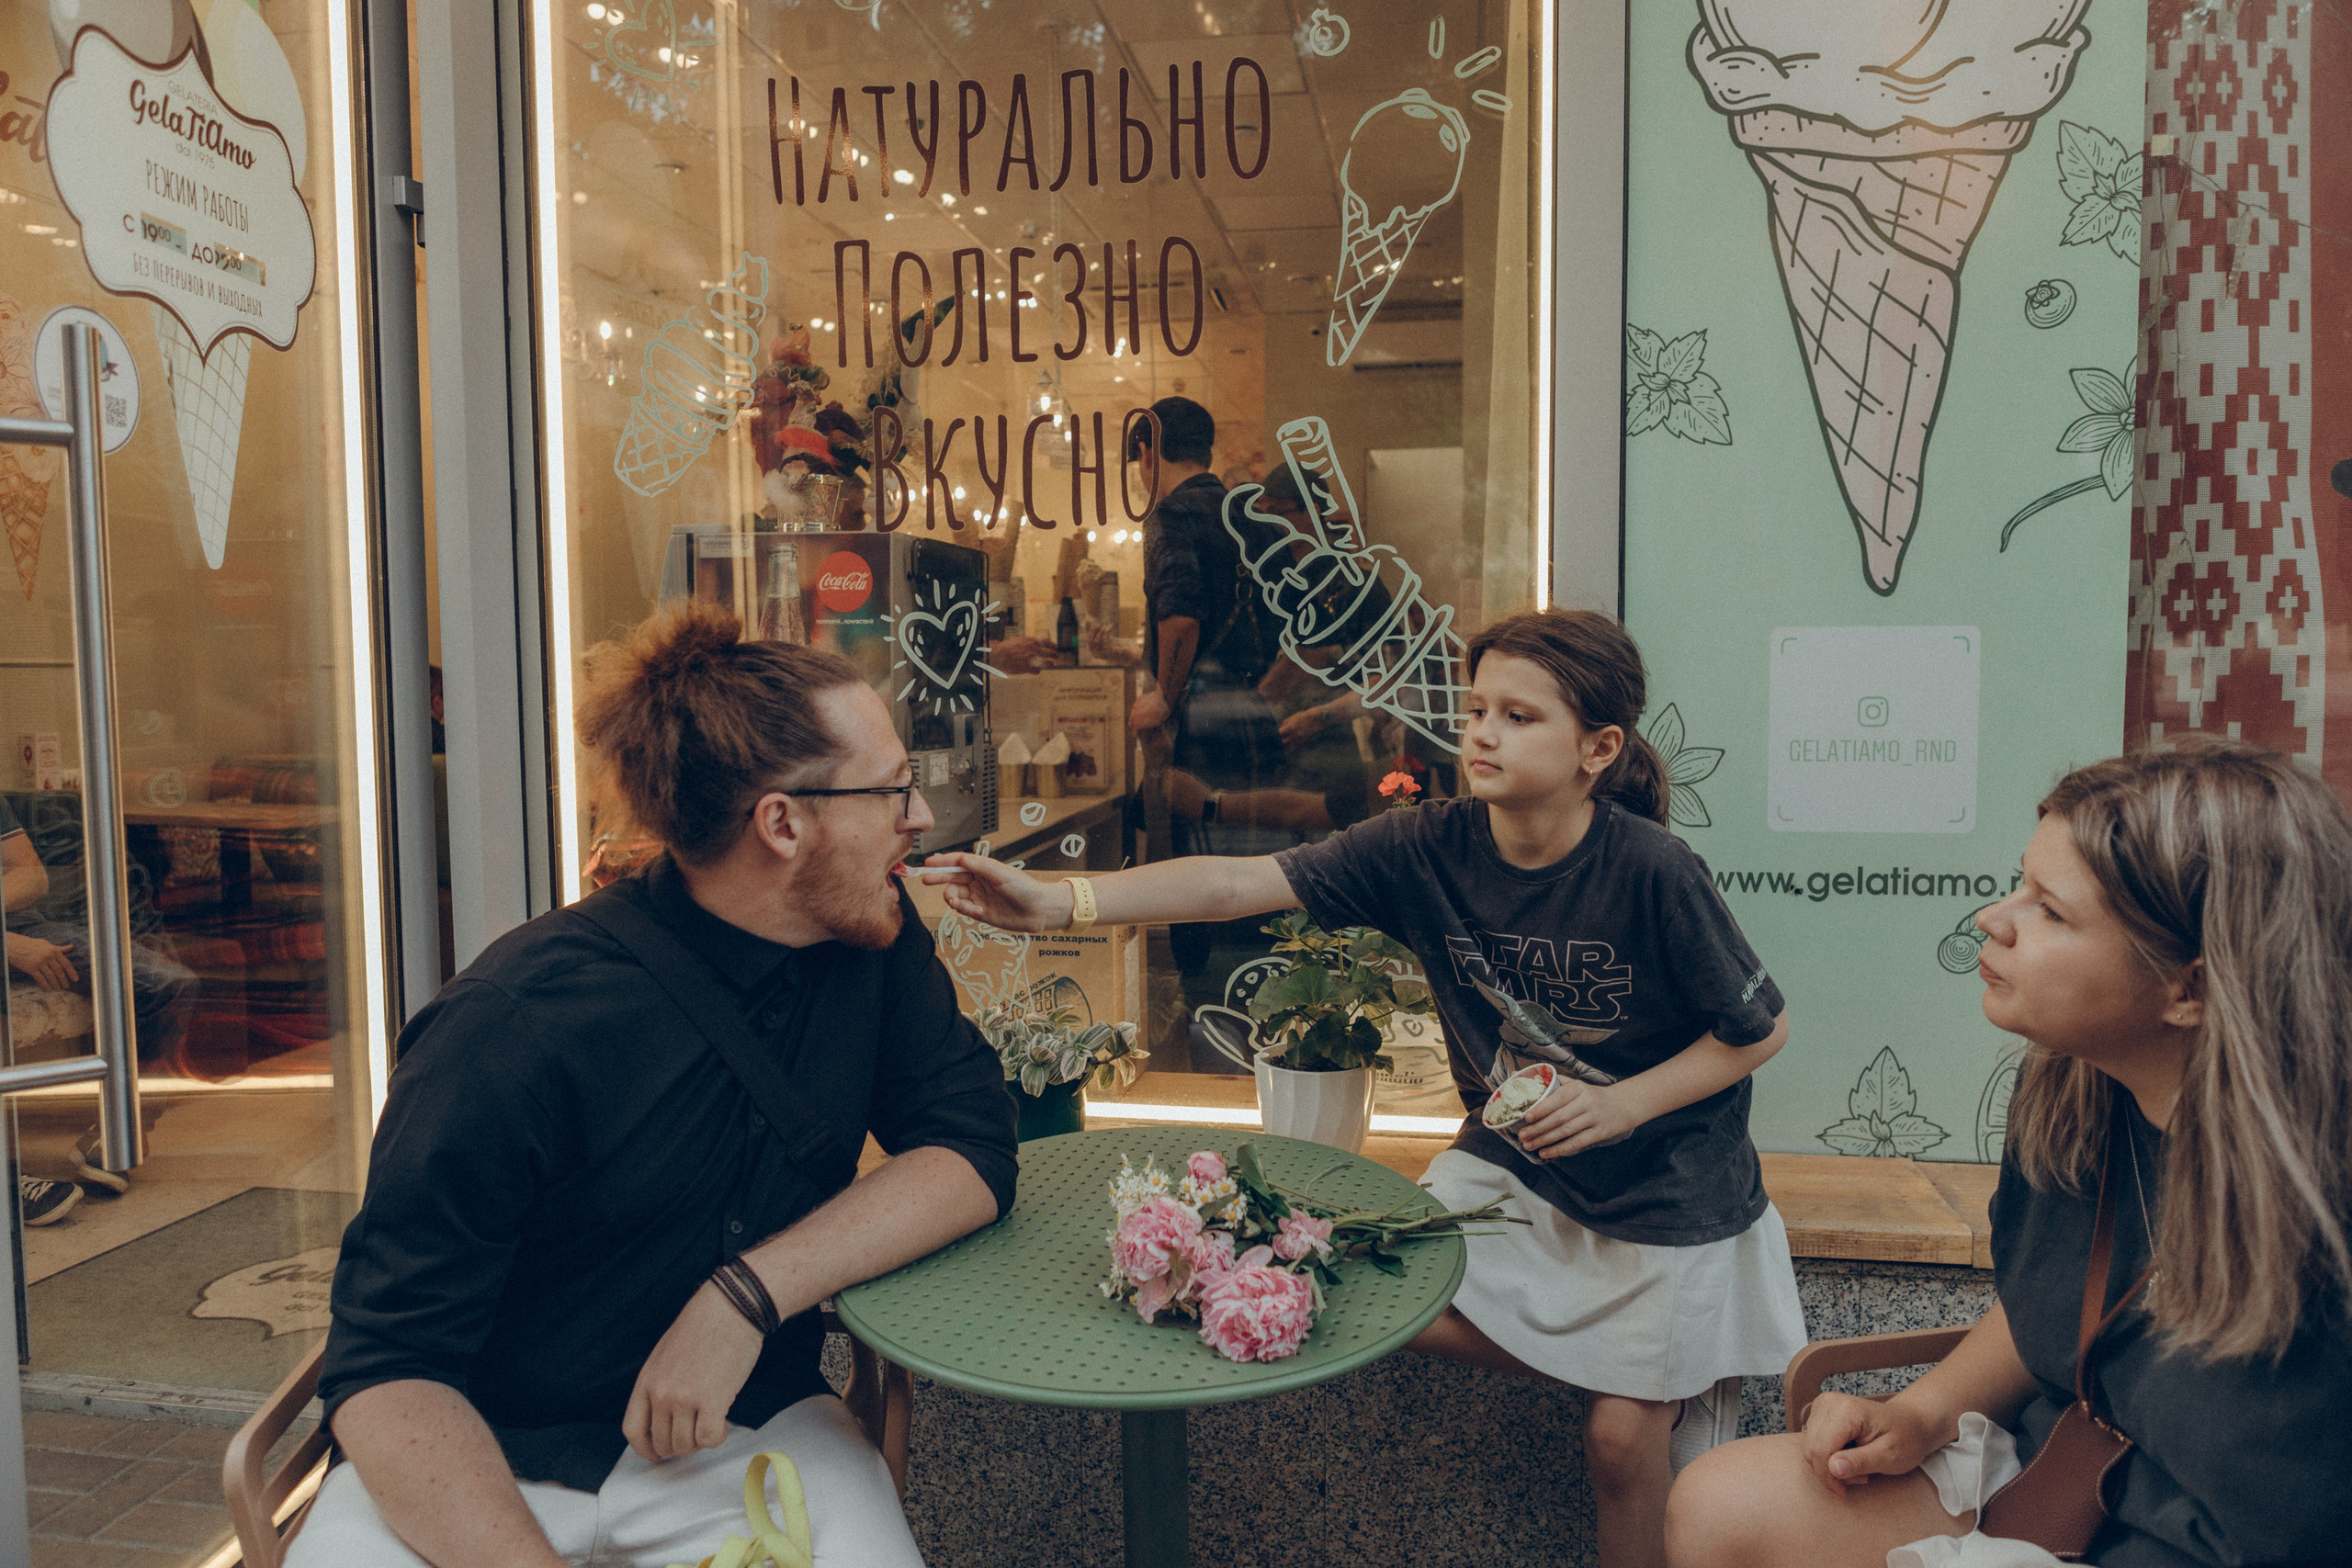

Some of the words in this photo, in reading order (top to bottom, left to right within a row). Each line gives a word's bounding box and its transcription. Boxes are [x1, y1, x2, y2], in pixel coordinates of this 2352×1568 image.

[175, 142, 191, 157] dal
[196, 149, 216, 169] 1975
[767, 56, 1271, 206] НАТУРАЛЬНО
[146, 159, 198, 211] РЕЖИМ
[203, 185, 249, 233] РАБОТЫ
[123, 213, 135, 232] С
[191, 243, 214, 265] ДО
[133, 253, 150, 277] БЕЗ
[153, 260, 205, 298] ПЕРЕРЫВОВ
[208, 281, 215, 301] И
[219, 285, 263, 318] ВЫХОДНЫХ
[834, 236, 1204, 368] ПОЛЕЗНО
[873, 405, 1161, 534] ВКУСНО
[1789, 739, 1957, 766] GELATIAMO_RND
[1038, 949, 1080, 957] рожков
[1051, 933, 1108, 944] сахарных
